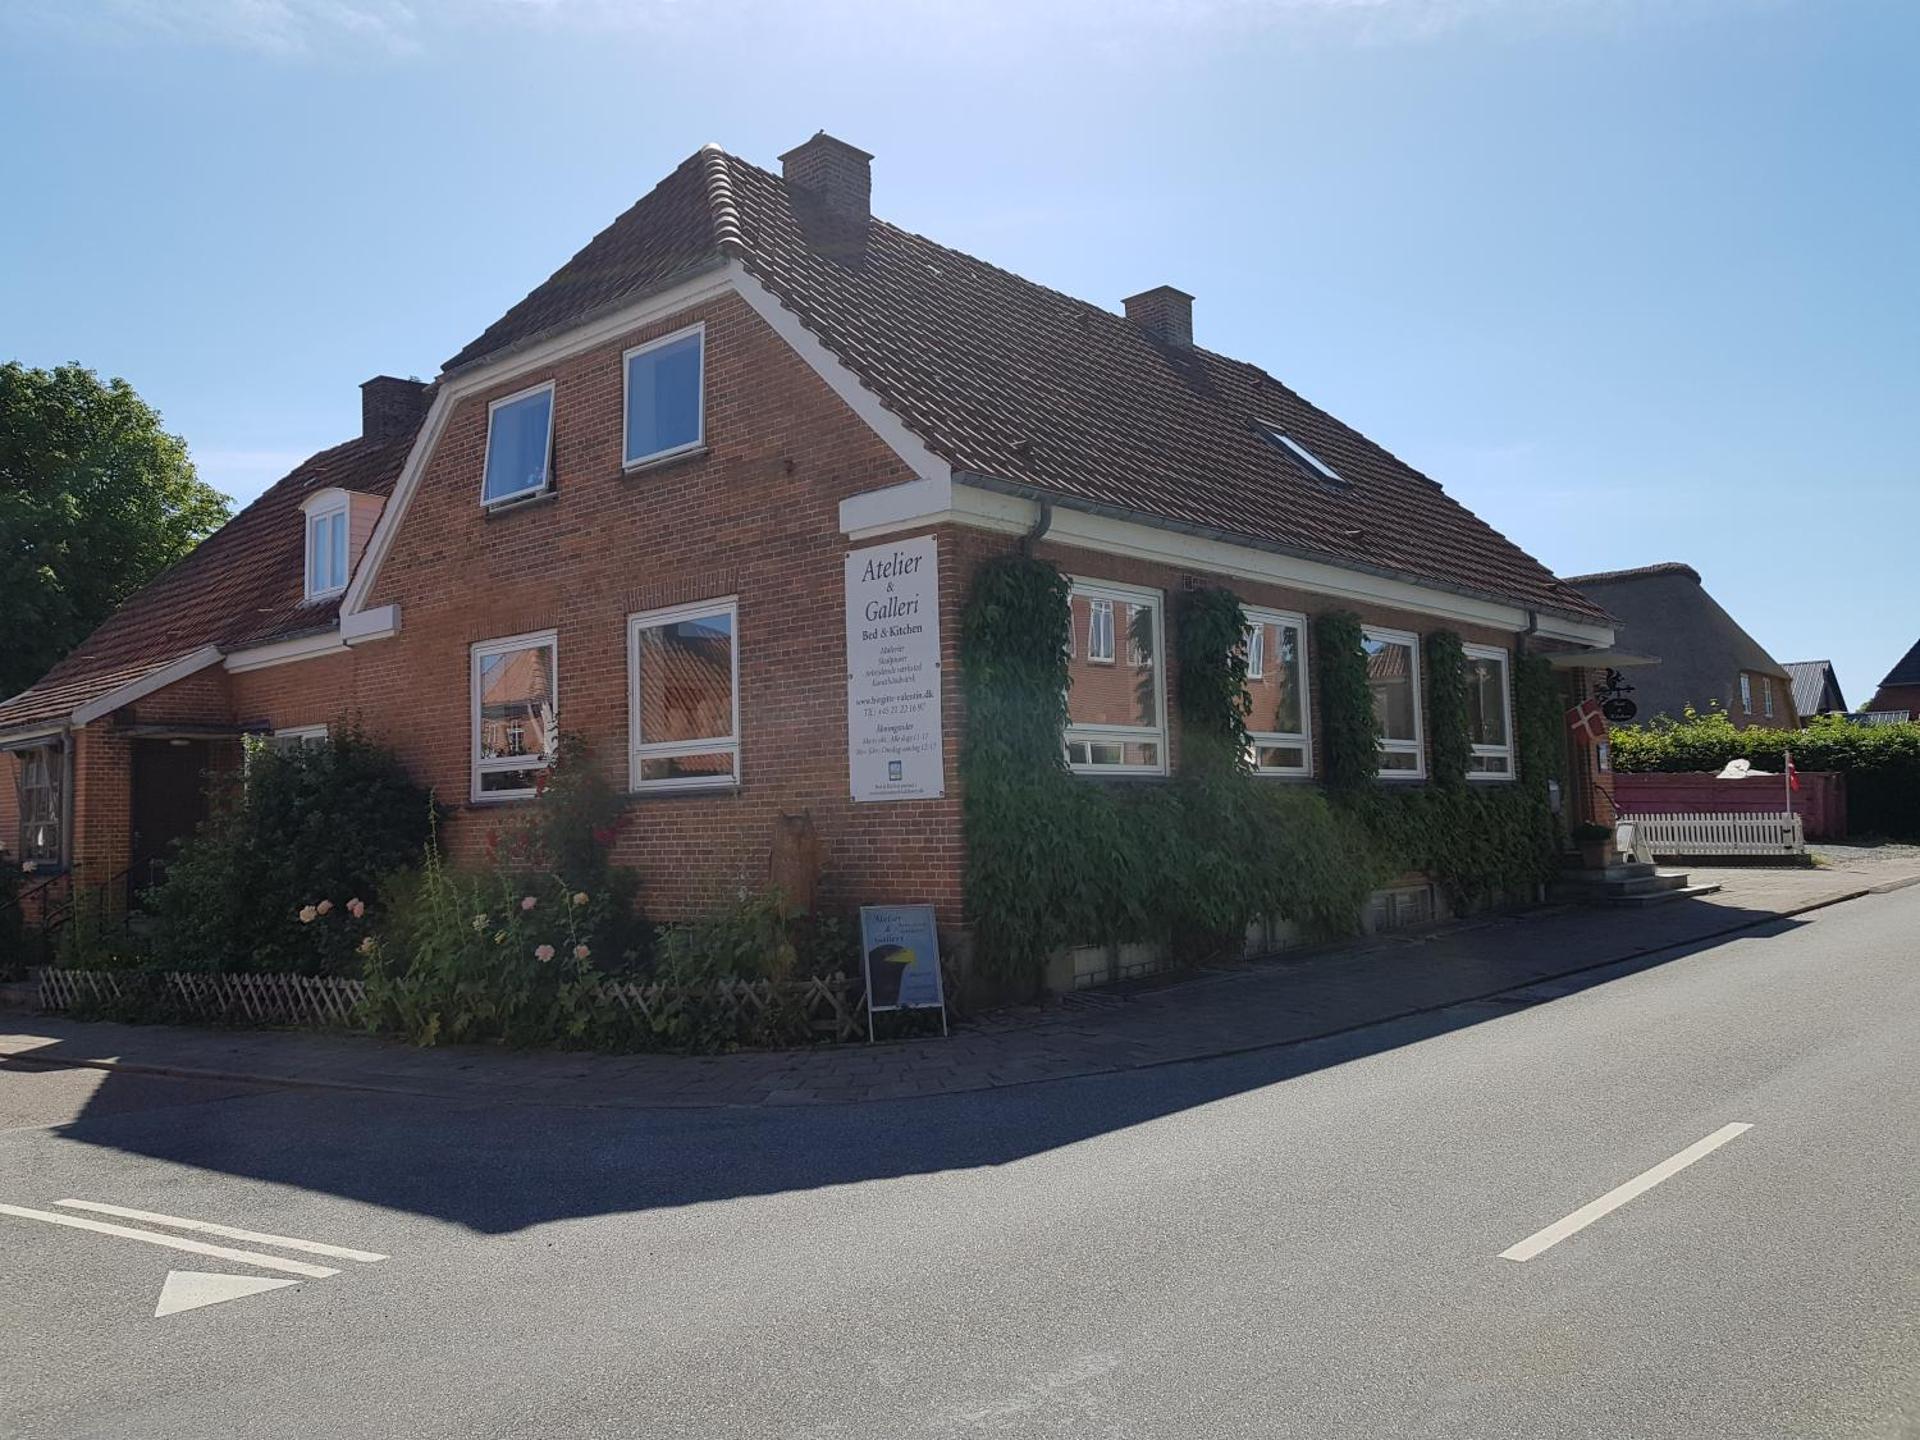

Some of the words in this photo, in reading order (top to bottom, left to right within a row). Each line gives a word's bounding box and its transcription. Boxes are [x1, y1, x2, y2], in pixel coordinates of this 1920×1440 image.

[862, 551, 922, 582] Atelier
[886, 581, 895, 593] &
[865, 593, 920, 622] Galleri
[862, 627, 878, 641] Bed
[880, 627, 889, 639] &
[890, 623, 922, 637] Kitchen
